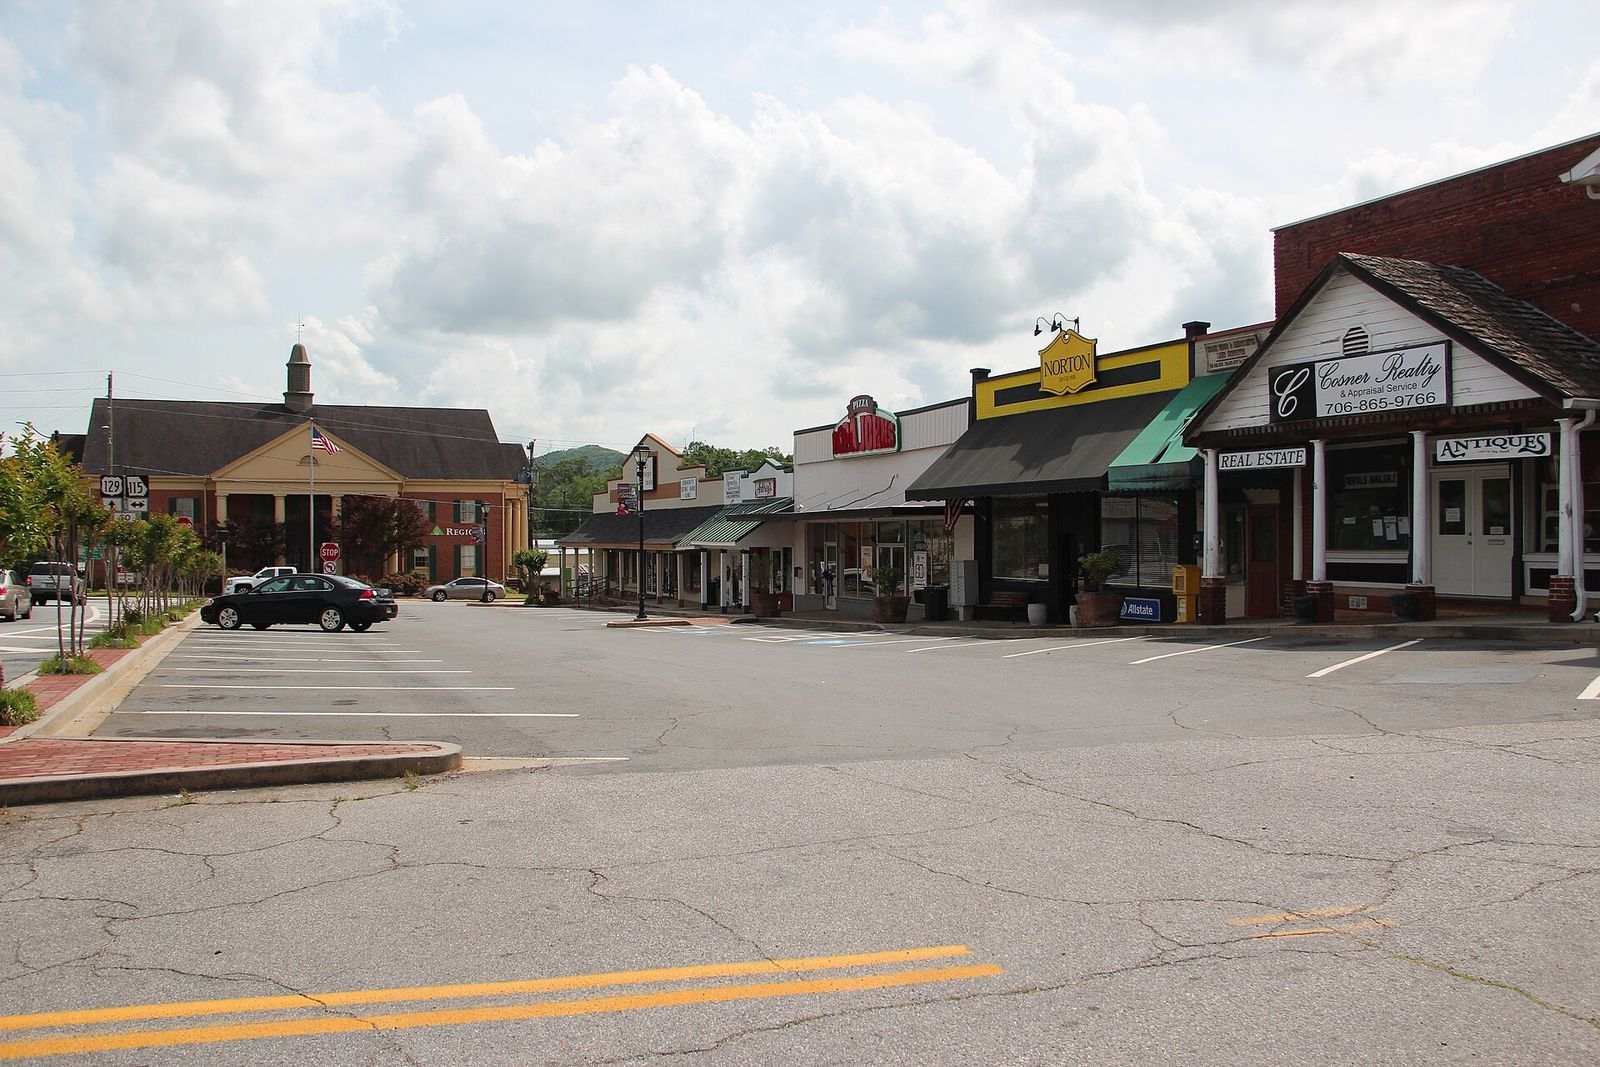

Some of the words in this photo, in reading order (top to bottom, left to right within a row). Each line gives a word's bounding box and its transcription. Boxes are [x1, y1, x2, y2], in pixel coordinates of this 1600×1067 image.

[1044, 352, 1091, 377] NORTON
[1319, 362, 1371, 390] Cosner
[1375, 352, 1442, 388] Realty
[1340, 390, 1346, 398] &
[1347, 385, 1385, 398] Appraisal
[1386, 382, 1418, 392] Service
[852, 398, 870, 410] PIZZA
[1325, 391, 1436, 415] 706-865-9766
[1440, 434, 1547, 458] ANTIQUES
[1221, 453, 1253, 468] REAL
[1257, 449, 1304, 466] ESTATE
[103, 480, 120, 493] 129
[128, 481, 143, 494] 115
[322, 548, 338, 557] STOP
[1127, 603, 1153, 616] Allstate
